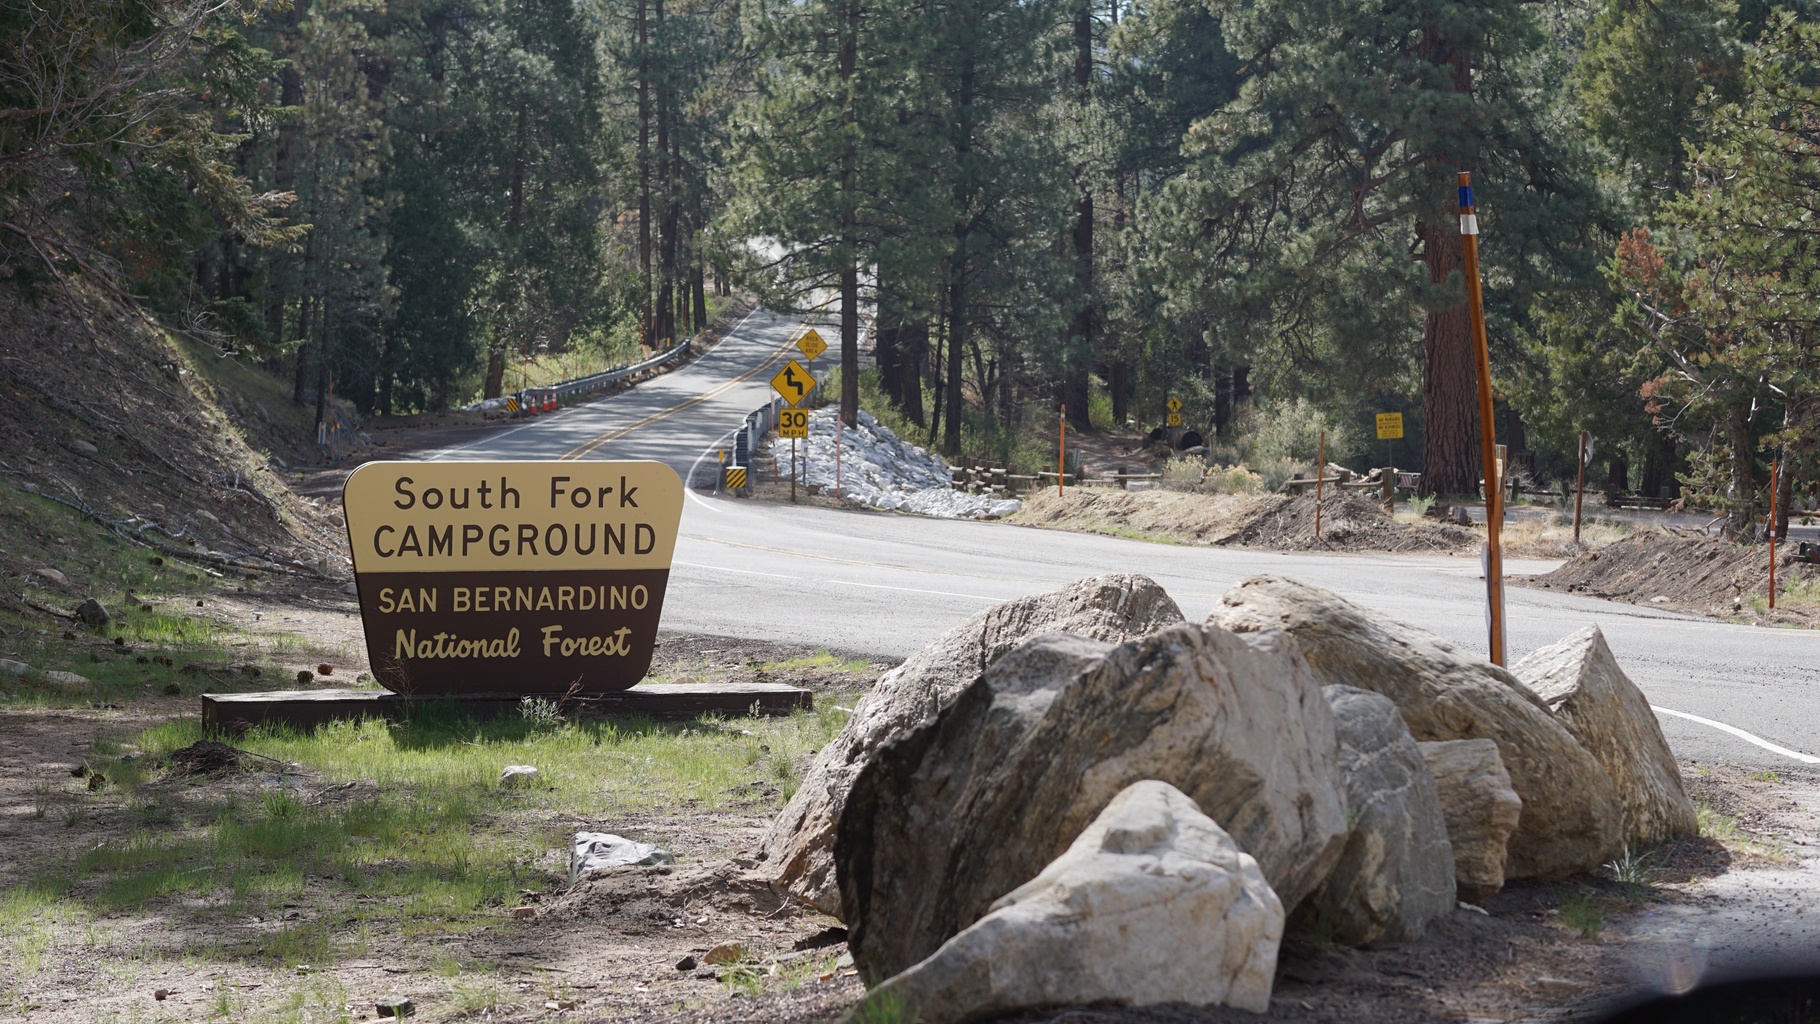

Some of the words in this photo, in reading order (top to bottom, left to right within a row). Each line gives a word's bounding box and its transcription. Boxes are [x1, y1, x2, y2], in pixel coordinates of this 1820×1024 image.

[781, 412, 806, 428] 30
[394, 476, 520, 510] South
[550, 475, 639, 509] Fork
[373, 522, 656, 558] CAMPGROUND
[378, 586, 437, 614] SAN
[453, 584, 649, 612] BERNARDINO
[394, 627, 521, 660] National
[541, 624, 632, 657] Forest
